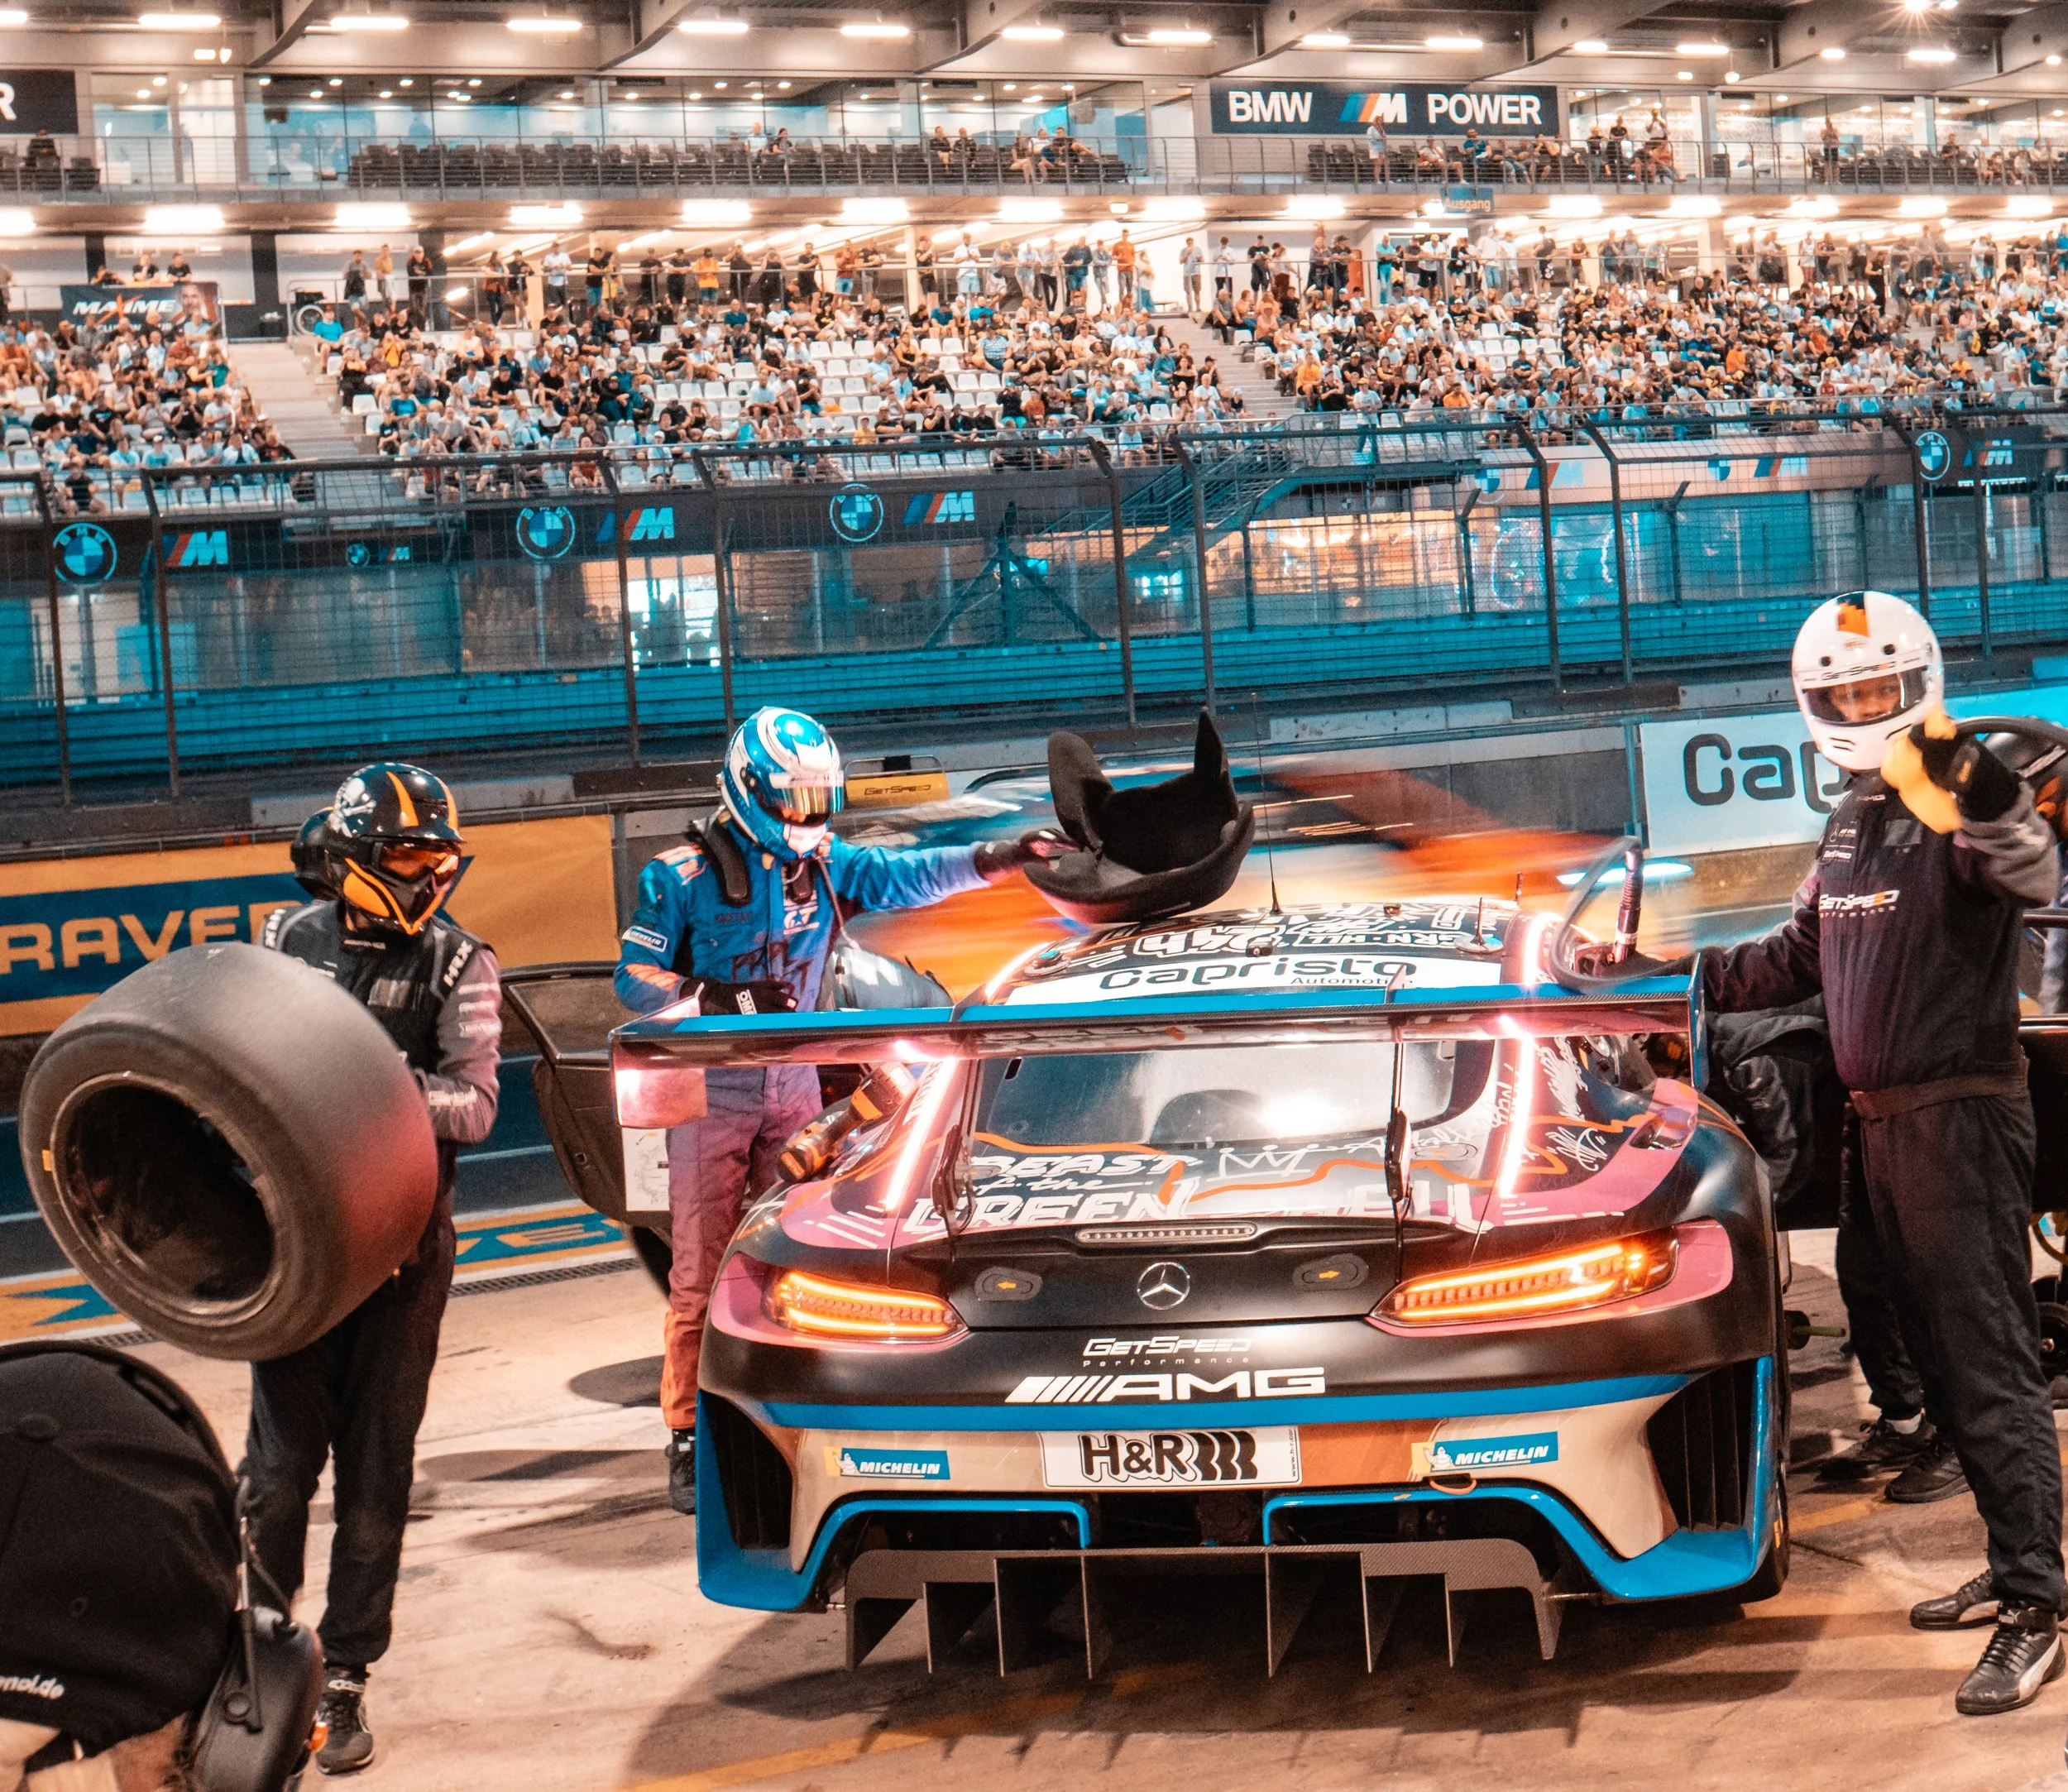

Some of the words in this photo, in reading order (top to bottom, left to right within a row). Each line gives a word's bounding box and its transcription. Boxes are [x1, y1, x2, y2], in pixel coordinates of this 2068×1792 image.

[1229, 91, 1313, 122] BMW
[1428, 94, 1542, 125] POWER
[1444, 199, 1491, 212] Ausgang
[443, 941, 473, 987] HRX
[1099, 956, 1417, 989] Capristo
[1290, 976, 1413, 985] Automotie
[902, 1178, 1201, 1237] GREEN
[1083, 1358, 1250, 1368] Performance
[1098, 1367, 1326, 1402] AMG
[859, 1461, 941, 1474] MICHELIN
[1079, 1434, 1191, 1479] H&R
[1454, 1445, 1549, 1465] MICHELIN
